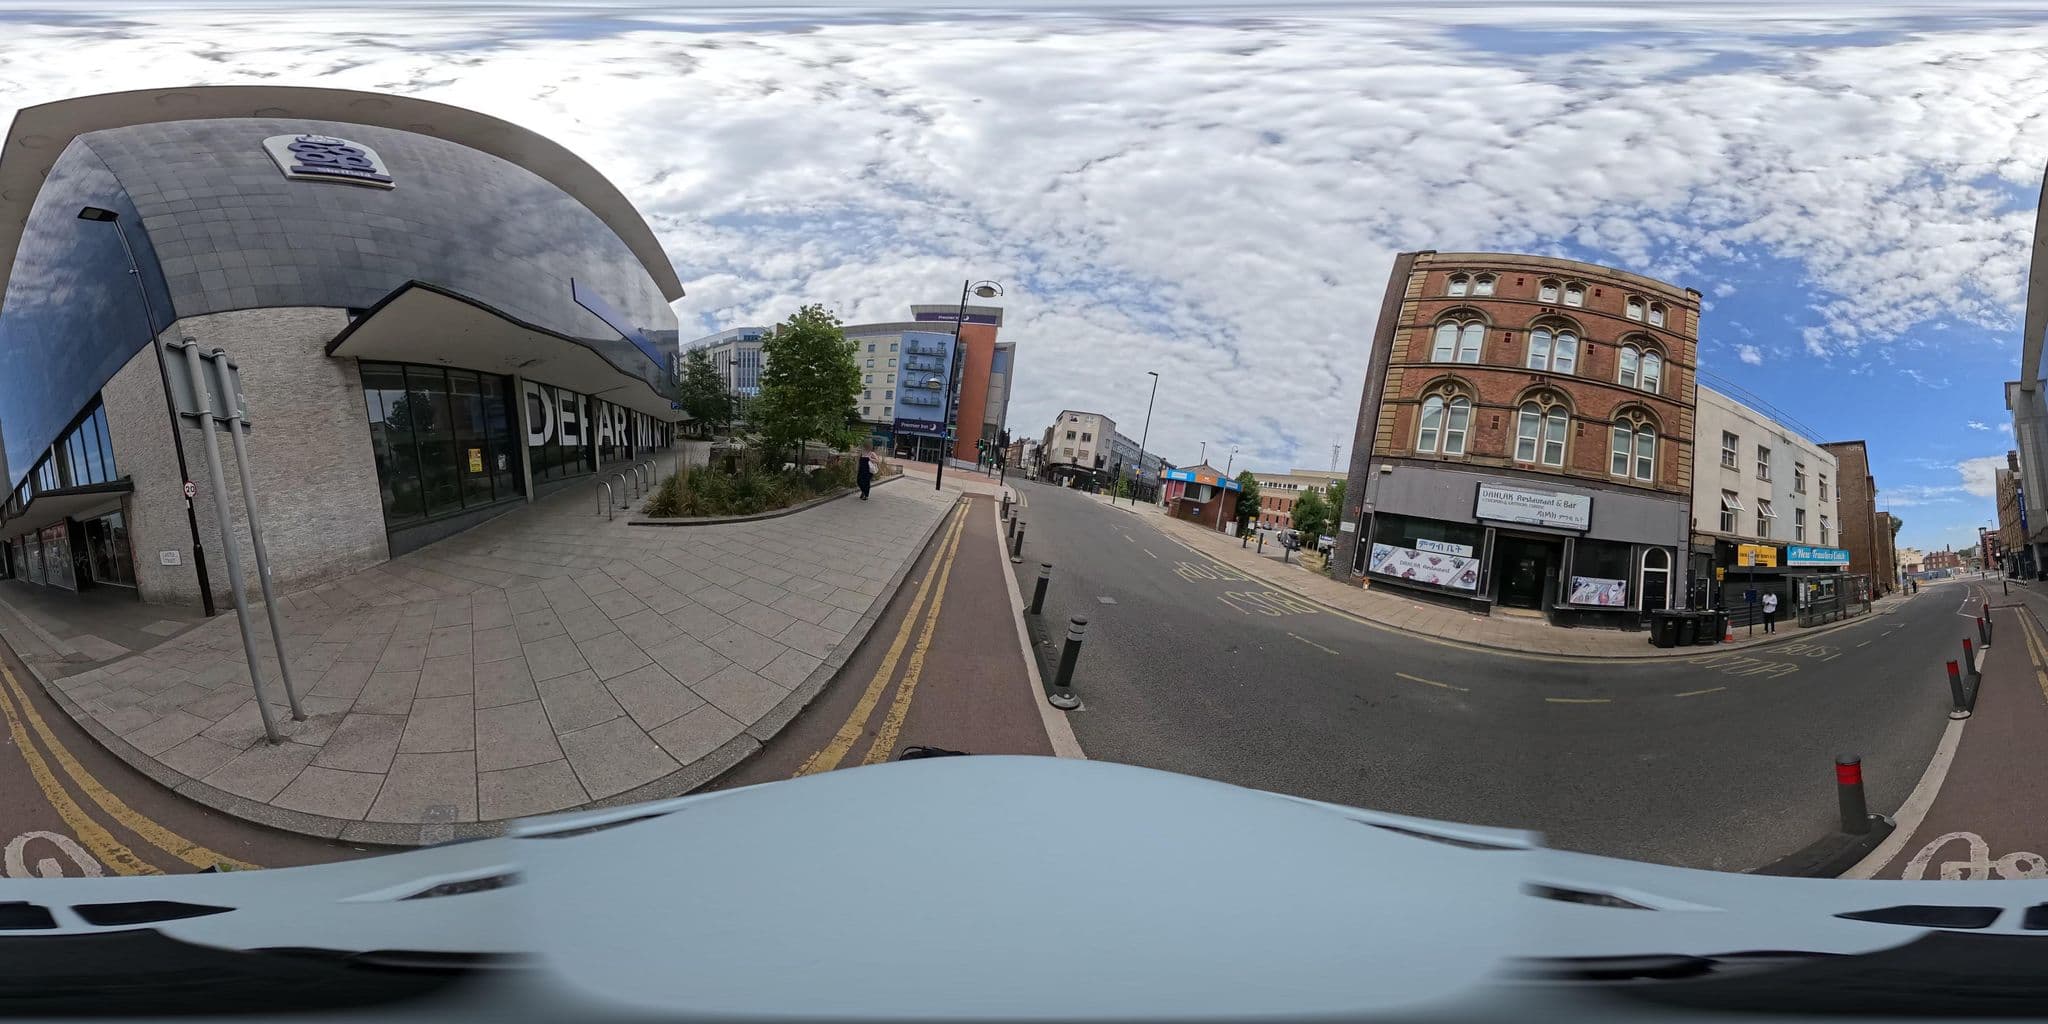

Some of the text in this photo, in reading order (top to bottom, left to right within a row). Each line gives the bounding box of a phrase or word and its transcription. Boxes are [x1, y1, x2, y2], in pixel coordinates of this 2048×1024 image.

[1482, 490, 1514, 501] DAHLAK
[1517, 495, 1554, 506] Restaurant
[1563, 501, 1576, 509] Bar
